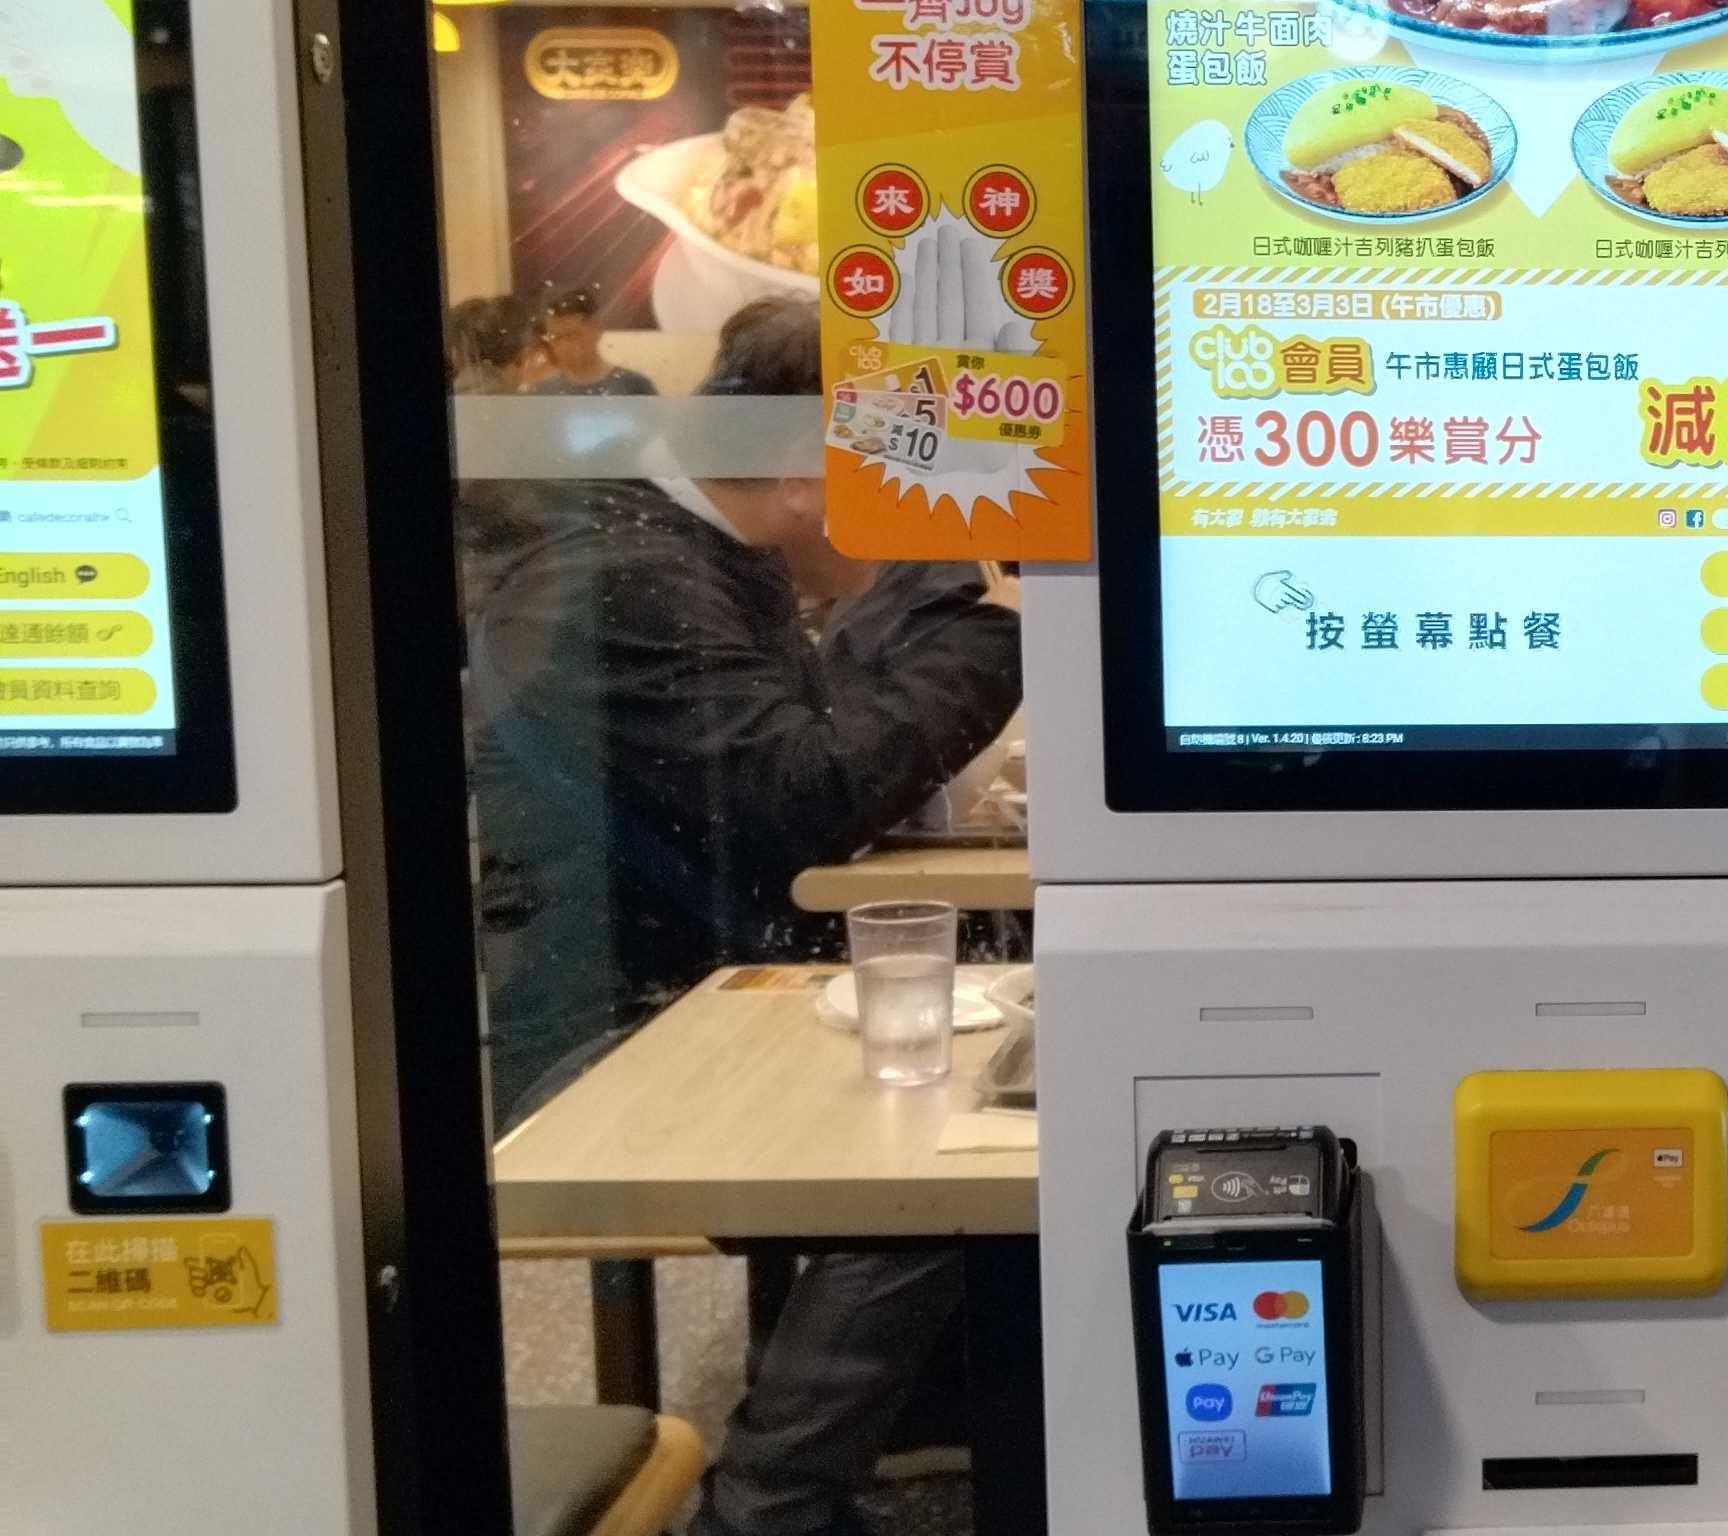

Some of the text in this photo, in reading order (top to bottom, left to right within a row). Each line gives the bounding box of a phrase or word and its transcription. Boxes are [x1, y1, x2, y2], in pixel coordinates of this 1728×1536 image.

[874, 39, 1015, 87] 不停賞
[1166, 48, 1268, 86] 蛋包飯
[843, 266, 886, 297] 如
[874, 185, 914, 217] 來
[979, 186, 1021, 218] 神
[1279, 340, 1366, 386] 會員
[1384, 350, 1640, 382] 午市惠顧日式蛋包飯
[953, 372, 1060, 420] $600
[1305, 610, 1561, 651] 按螢幕點餐
[1173, 1302, 1238, 1323] VISA
[1198, 1348, 1240, 1370] Pay
[1280, 1346, 1317, 1366] Pay
